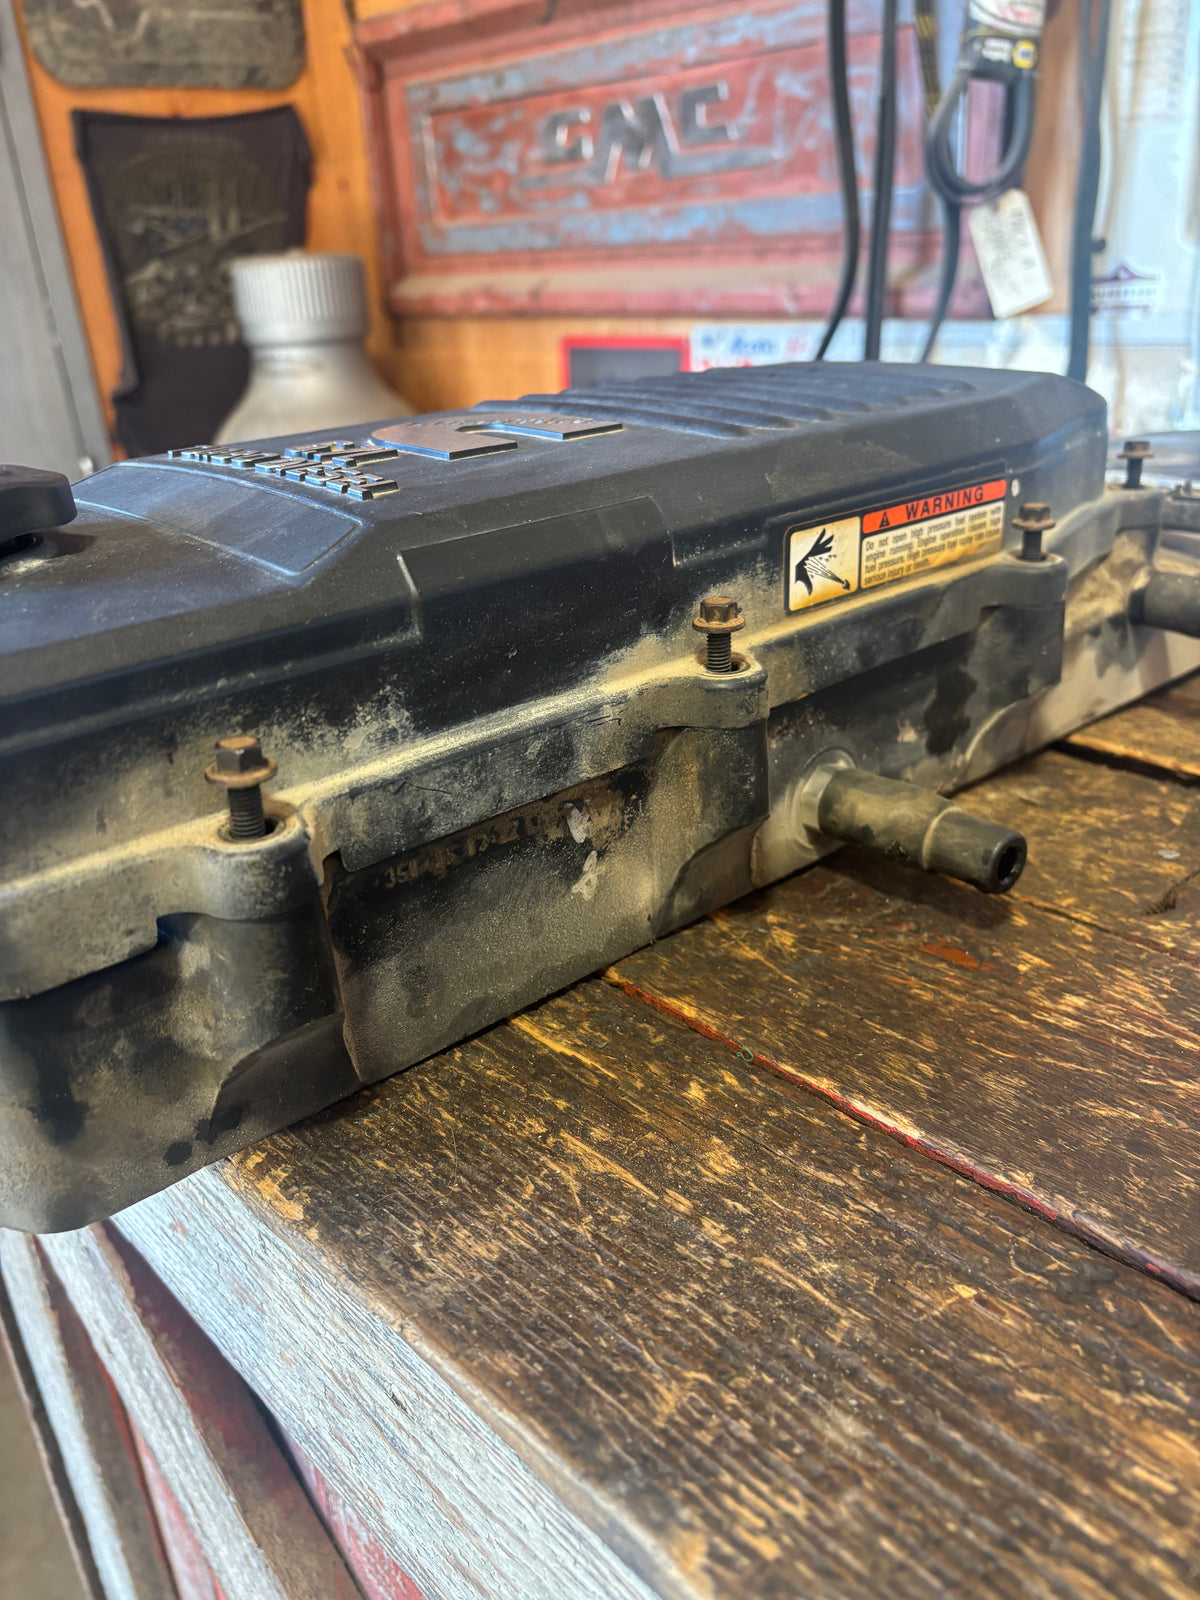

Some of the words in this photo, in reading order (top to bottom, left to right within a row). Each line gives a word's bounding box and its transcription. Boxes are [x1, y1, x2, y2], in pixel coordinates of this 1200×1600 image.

[540, 82, 741, 183] GMC
[255, 457, 399, 501] DIESEL
[905, 487, 984, 520] WARNING
[865, 541, 874, 551] Do
[878, 537, 888, 547] not
[892, 533, 907, 544] open
[911, 527, 923, 539] high
[928, 521, 951, 535] pressure
[865, 550, 886, 563] engine
[865, 562, 876, 574] fuel
[864, 572, 886, 586] serious
